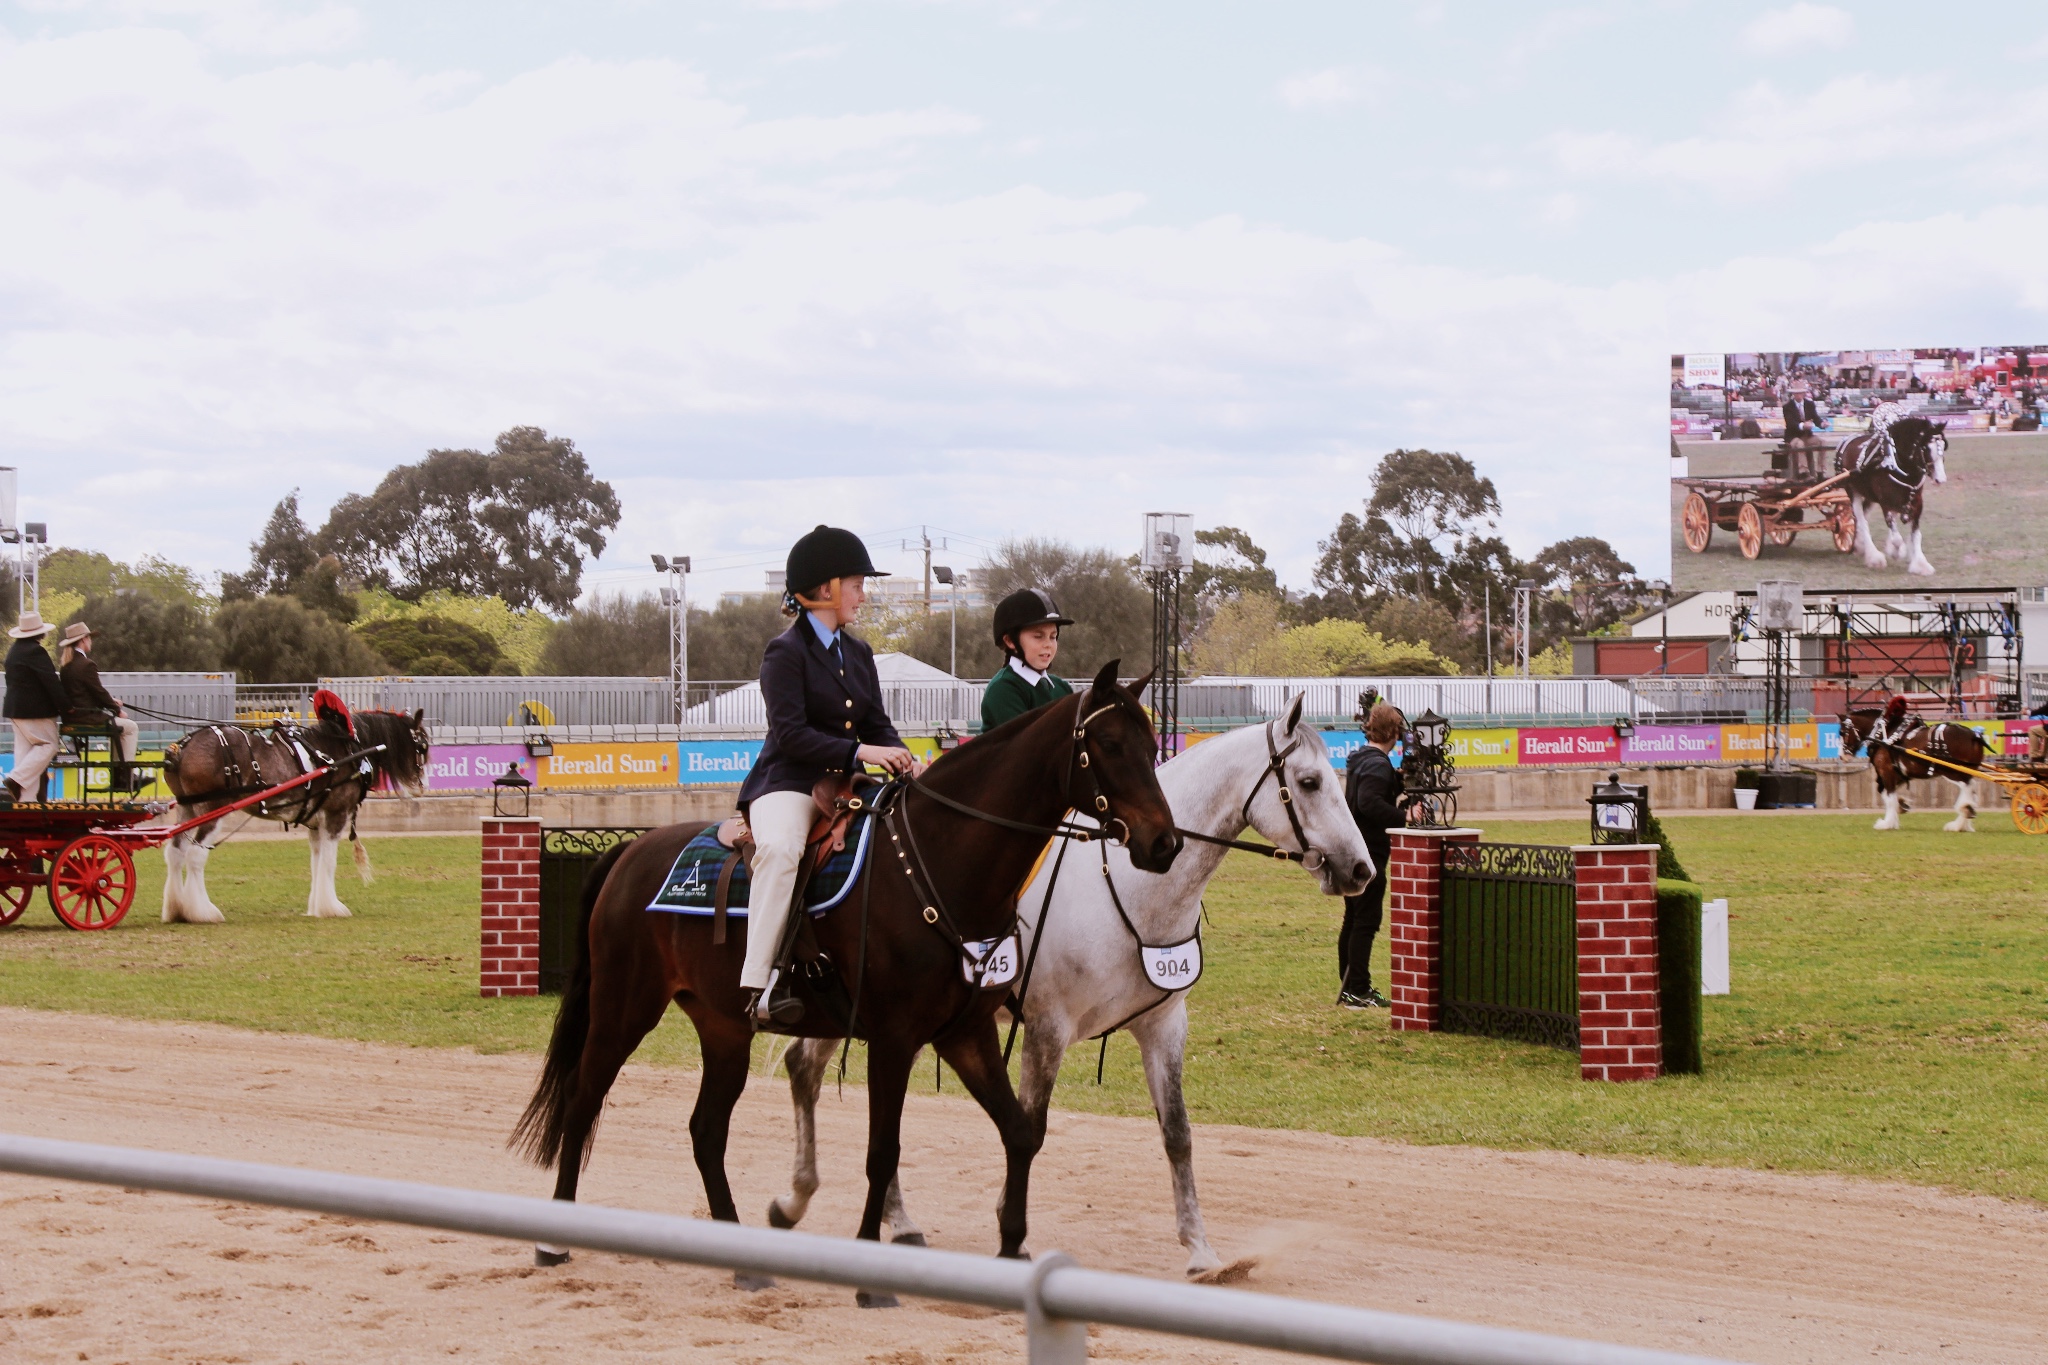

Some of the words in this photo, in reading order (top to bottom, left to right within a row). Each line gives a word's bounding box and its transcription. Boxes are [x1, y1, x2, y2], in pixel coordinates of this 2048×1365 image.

[1704, 604, 1733, 617] HOR
[1472, 738, 1502, 755] Sun
[1525, 736, 1574, 754] Herald
[1577, 736, 1606, 753] Sun
[1628, 734, 1677, 752] Herald
[1678, 733, 1706, 751] Sun
[427, 756, 469, 778] rald
[547, 753, 614, 775] Herald
[619, 753, 658, 773] Sun
[687, 751, 751, 772] Herald
[12, 802, 125, 812] DRYSDALE
[1155, 958, 1191, 977] 904
